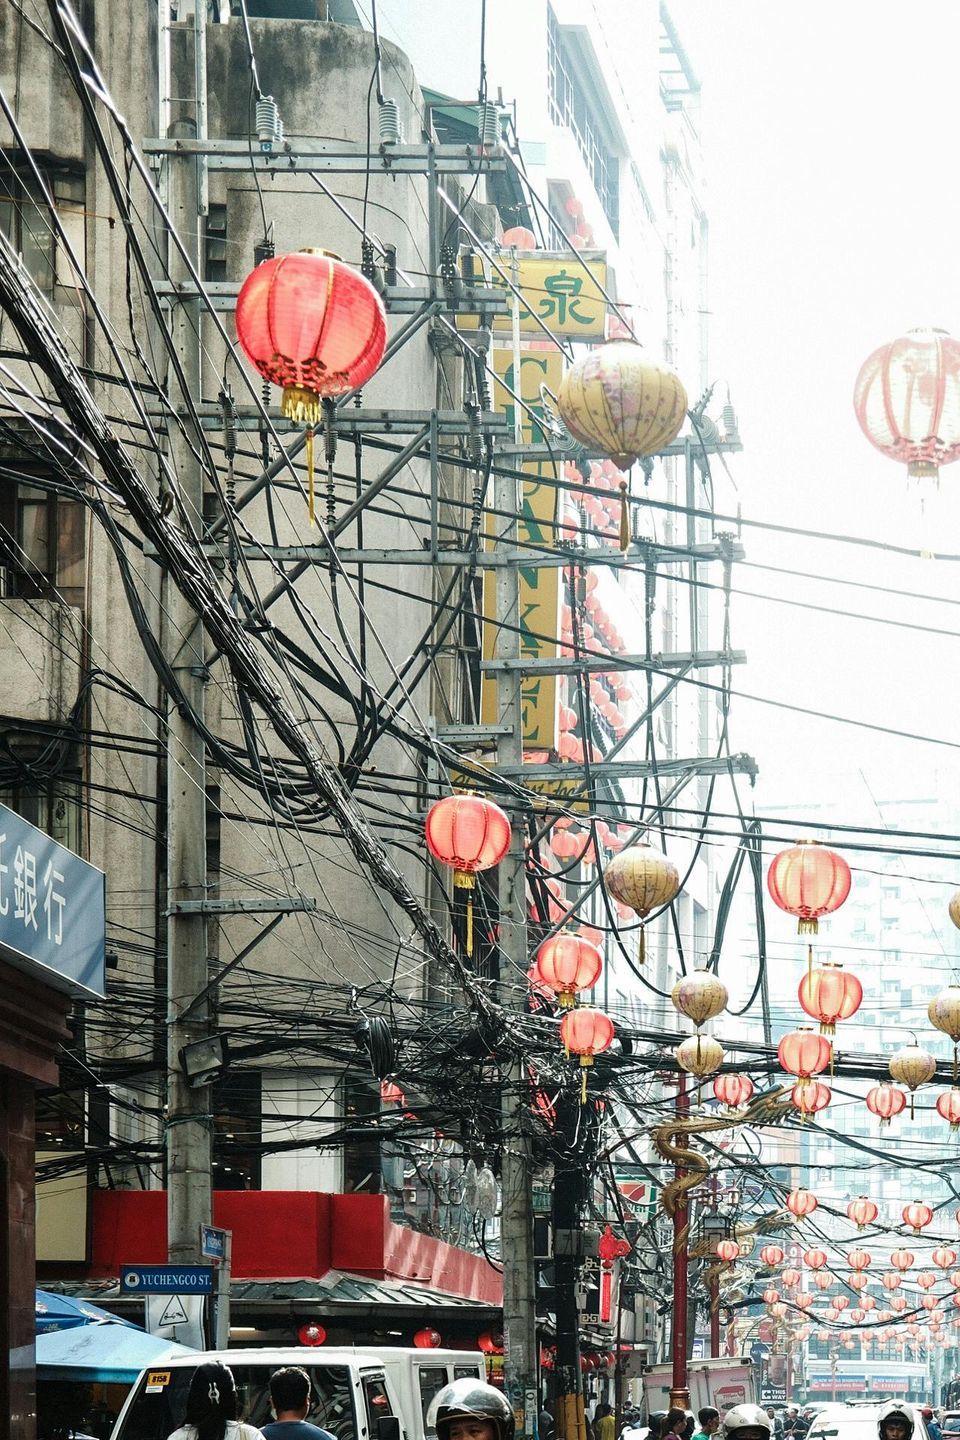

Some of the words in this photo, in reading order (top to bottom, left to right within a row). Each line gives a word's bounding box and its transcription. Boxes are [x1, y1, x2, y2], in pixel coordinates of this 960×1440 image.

[500, 357, 549, 589] CHA
[142, 1274, 197, 1286] YUCHENGCO
[198, 1274, 212, 1286] ST.
